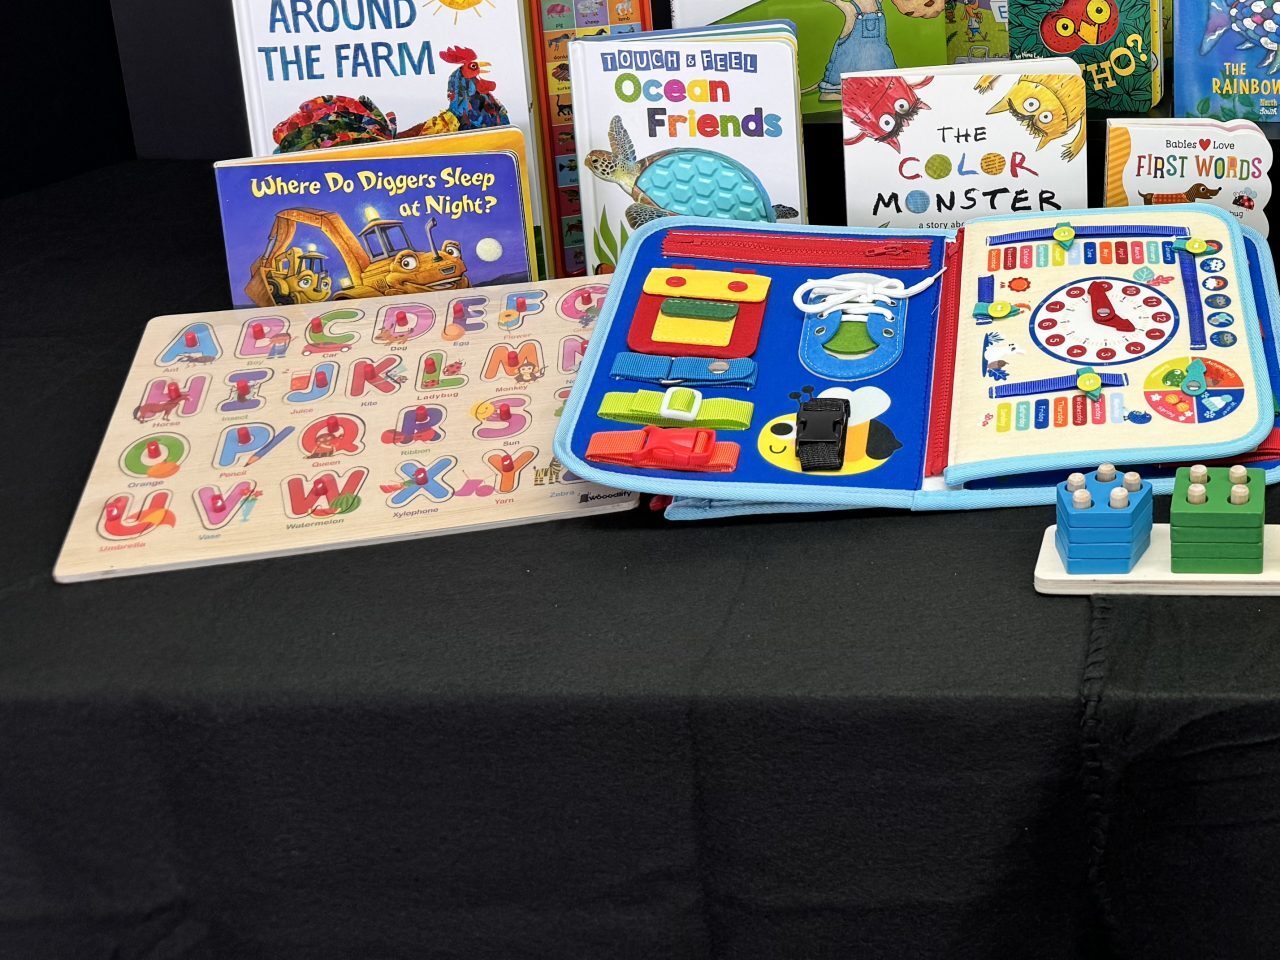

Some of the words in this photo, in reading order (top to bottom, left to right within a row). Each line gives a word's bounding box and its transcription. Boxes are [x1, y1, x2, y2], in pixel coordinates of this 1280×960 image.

[258, 46, 325, 81] THE
[336, 41, 436, 78] FARM
[602, 50, 679, 71] TOUCH
[702, 51, 756, 71] FEEL
[1080, 34, 1147, 91] HO?
[1224, 62, 1246, 76] THE
[614, 72, 730, 103] Ocean
[647, 107, 783, 138] Friends
[937, 126, 987, 143] THE
[1166, 139, 1197, 149] Babies
[1213, 141, 1235, 150] Love
[898, 152, 1039, 180] COLOR
[1136, 154, 1188, 179] FIRST
[1195, 155, 1263, 180] WORDS
[251, 175, 321, 198] Where
[325, 172, 354, 193] Do
[357, 171, 436, 197] Diggers
[440, 167, 495, 191] Sleep
[399, 200, 420, 217] at
[425, 195, 497, 219] Night?
[872, 188, 1062, 216] MONSTER
[926, 221, 948, 229] story
[161, 324, 219, 363] A
[239, 318, 286, 355] B
[377, 304, 433, 340] D
[452, 297, 487, 331] E
[142, 375, 206, 418] H
[286, 363, 335, 403] J
[351, 357, 398, 397] K
[422, 352, 465, 389] L
[484, 343, 540, 379] M
[124, 434, 185, 475] O
[219, 425, 273, 467] P
[400, 406, 444, 441] R
[477, 397, 527, 438] S
[104, 491, 170, 536] U
[199, 481, 251, 525] V
[391, 458, 454, 504] X
[487, 451, 535, 493] Y
[286, 518, 345, 530] Watermelon
